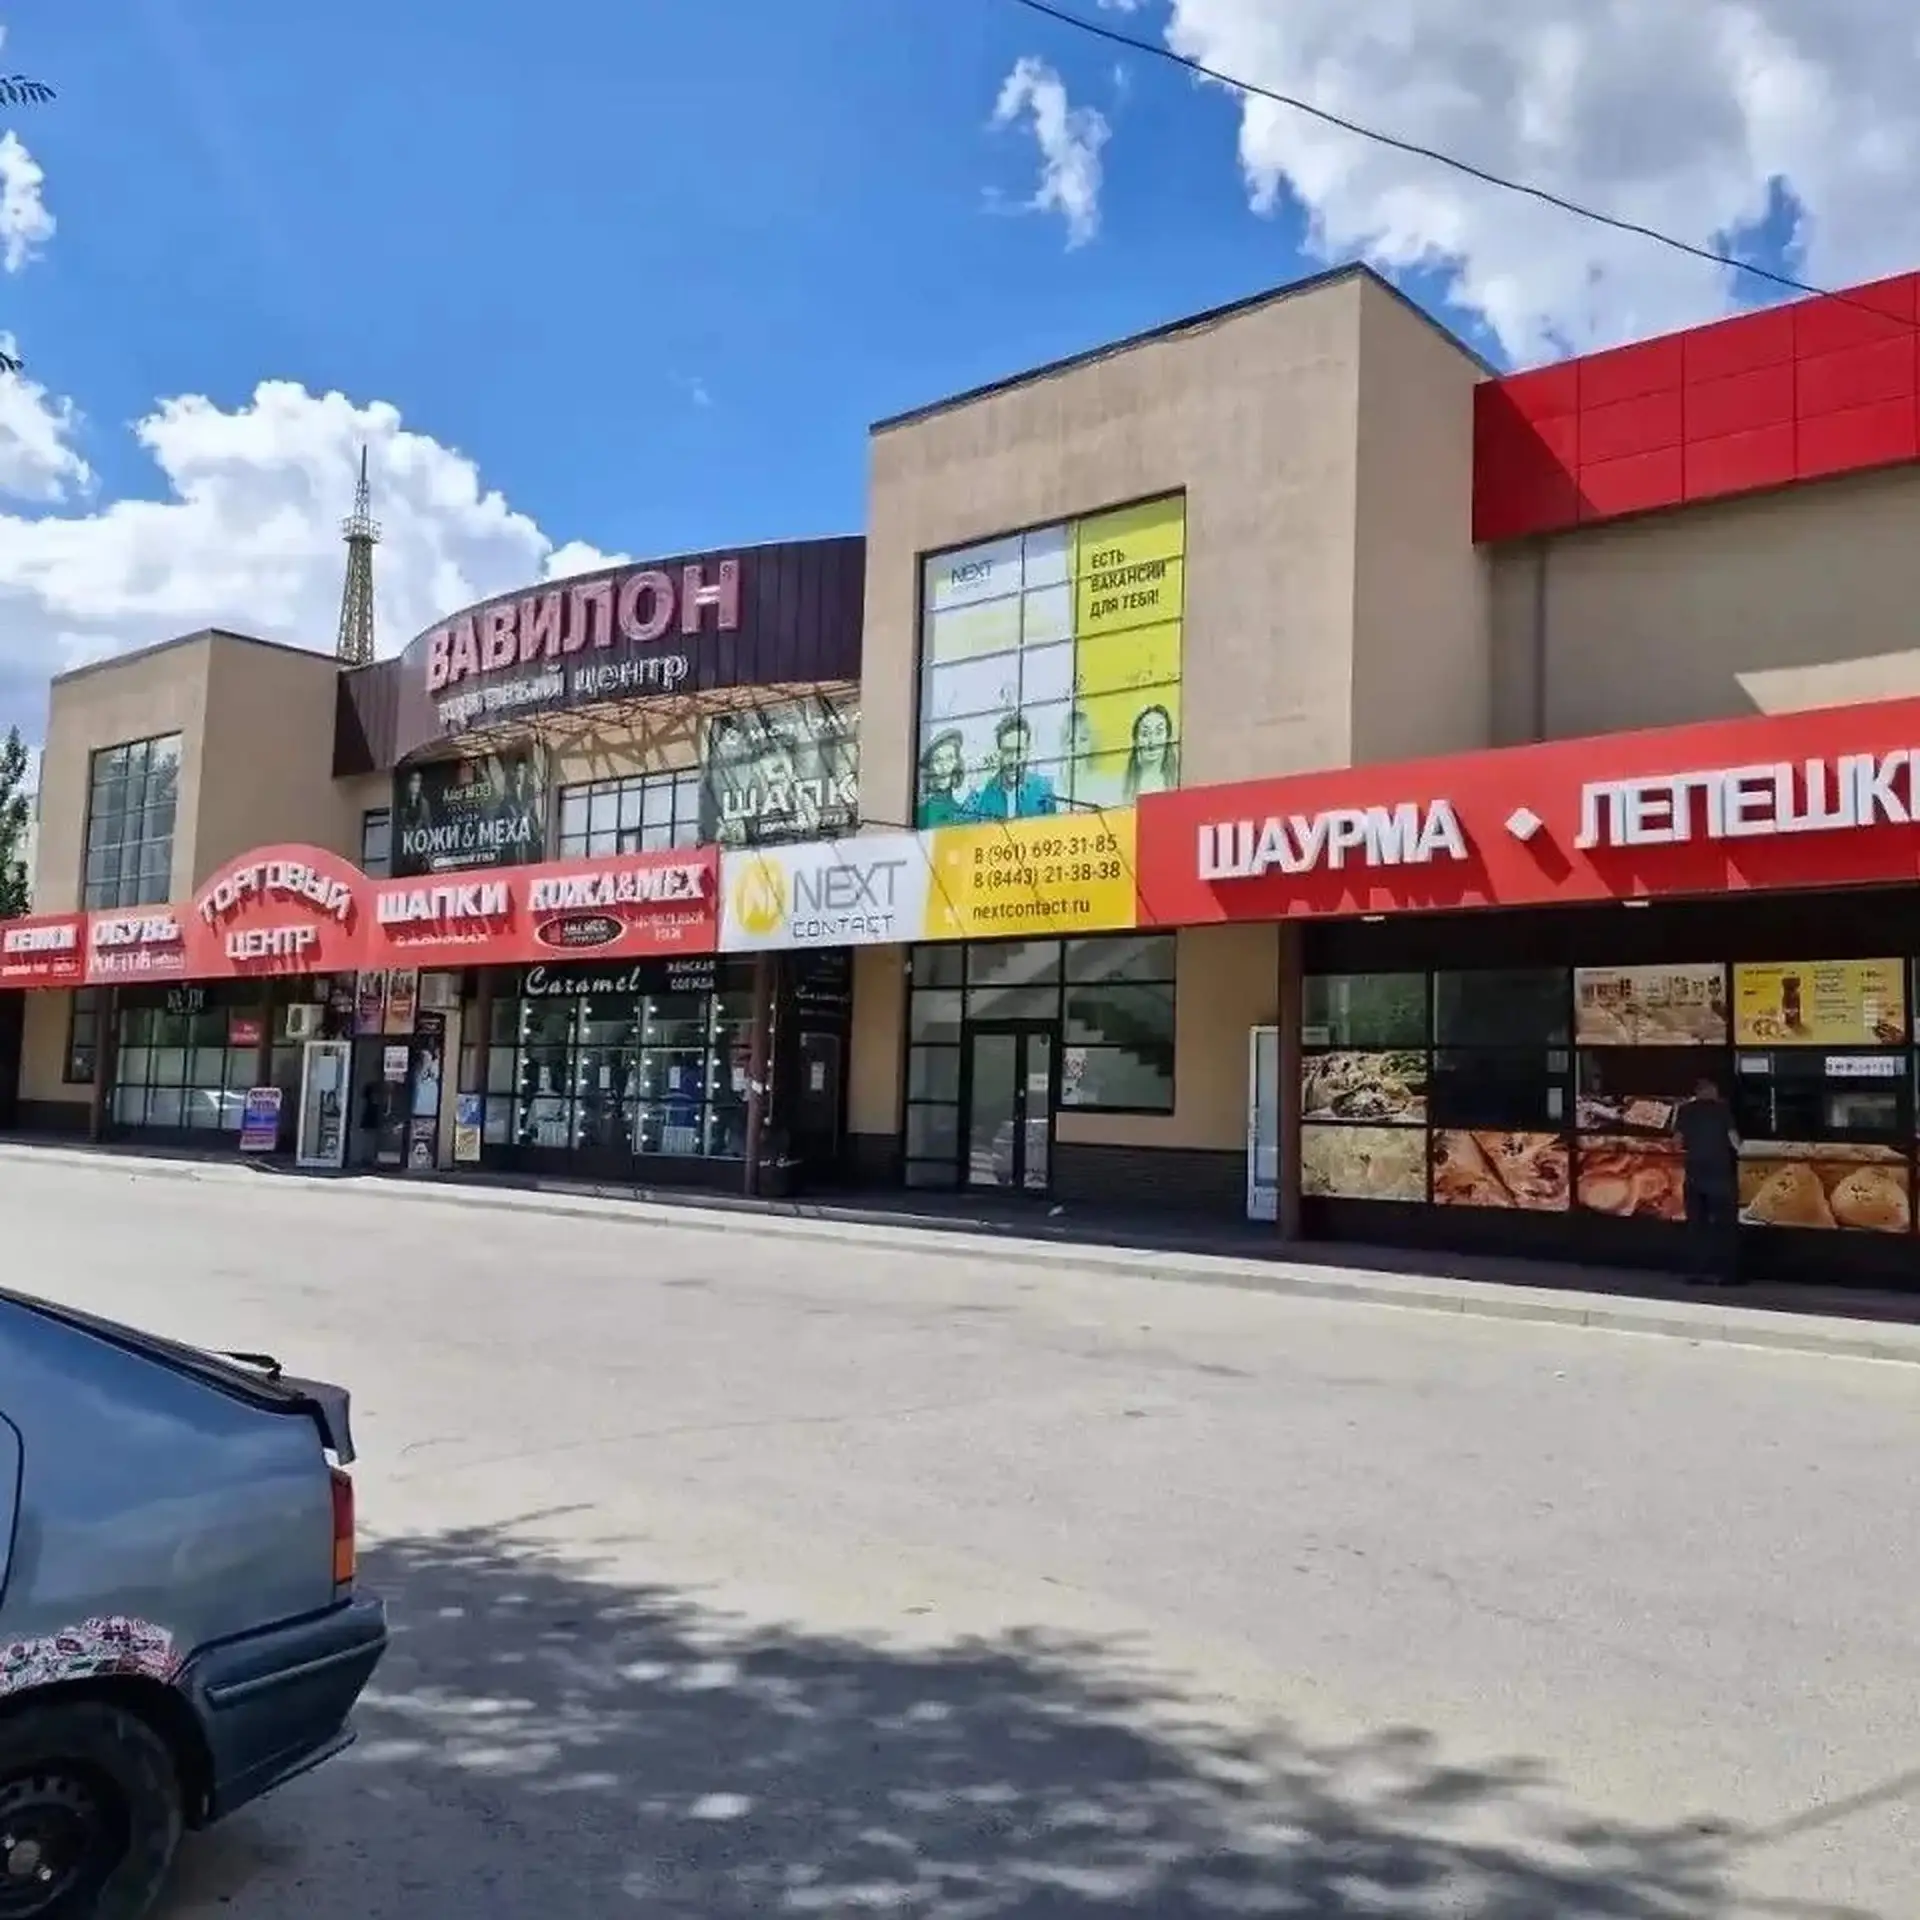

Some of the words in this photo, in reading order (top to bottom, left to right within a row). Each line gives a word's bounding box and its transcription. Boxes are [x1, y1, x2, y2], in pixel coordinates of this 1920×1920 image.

[951, 559, 993, 583] NEXT
[1091, 560, 1166, 593] ВАКАНСИИ
[1092, 549, 1125, 569] ЕСТЬ
[1089, 598, 1119, 620] ДЛЯ
[1122, 588, 1159, 609] ТЕБЯ!
[426, 559, 740, 693] ВАВИЛОН
[574, 655, 689, 694] центр
[723, 774, 859, 820] ШАПК
[403, 825, 460, 856] КОЖИ
[478, 816, 532, 847] МЕХА
[974, 847, 984, 864] 8
[1032, 834, 1118, 859] 692-31-85
[1198, 799, 1469, 880] ШАУРМА
[199, 861, 353, 922] ТОРГОВЫЙ
[793, 860, 908, 913] NEXT
[974, 872, 984, 888] 8
[988, 866, 1038, 892] (8443)
[1044, 860, 1121, 884] 21-38-38
[377, 881, 509, 925] ШАПКИ
[226, 925, 319, 961] ЦЕНТР
[793, 915, 894, 938] CONTACT
[524, 965, 641, 996] Caramel
